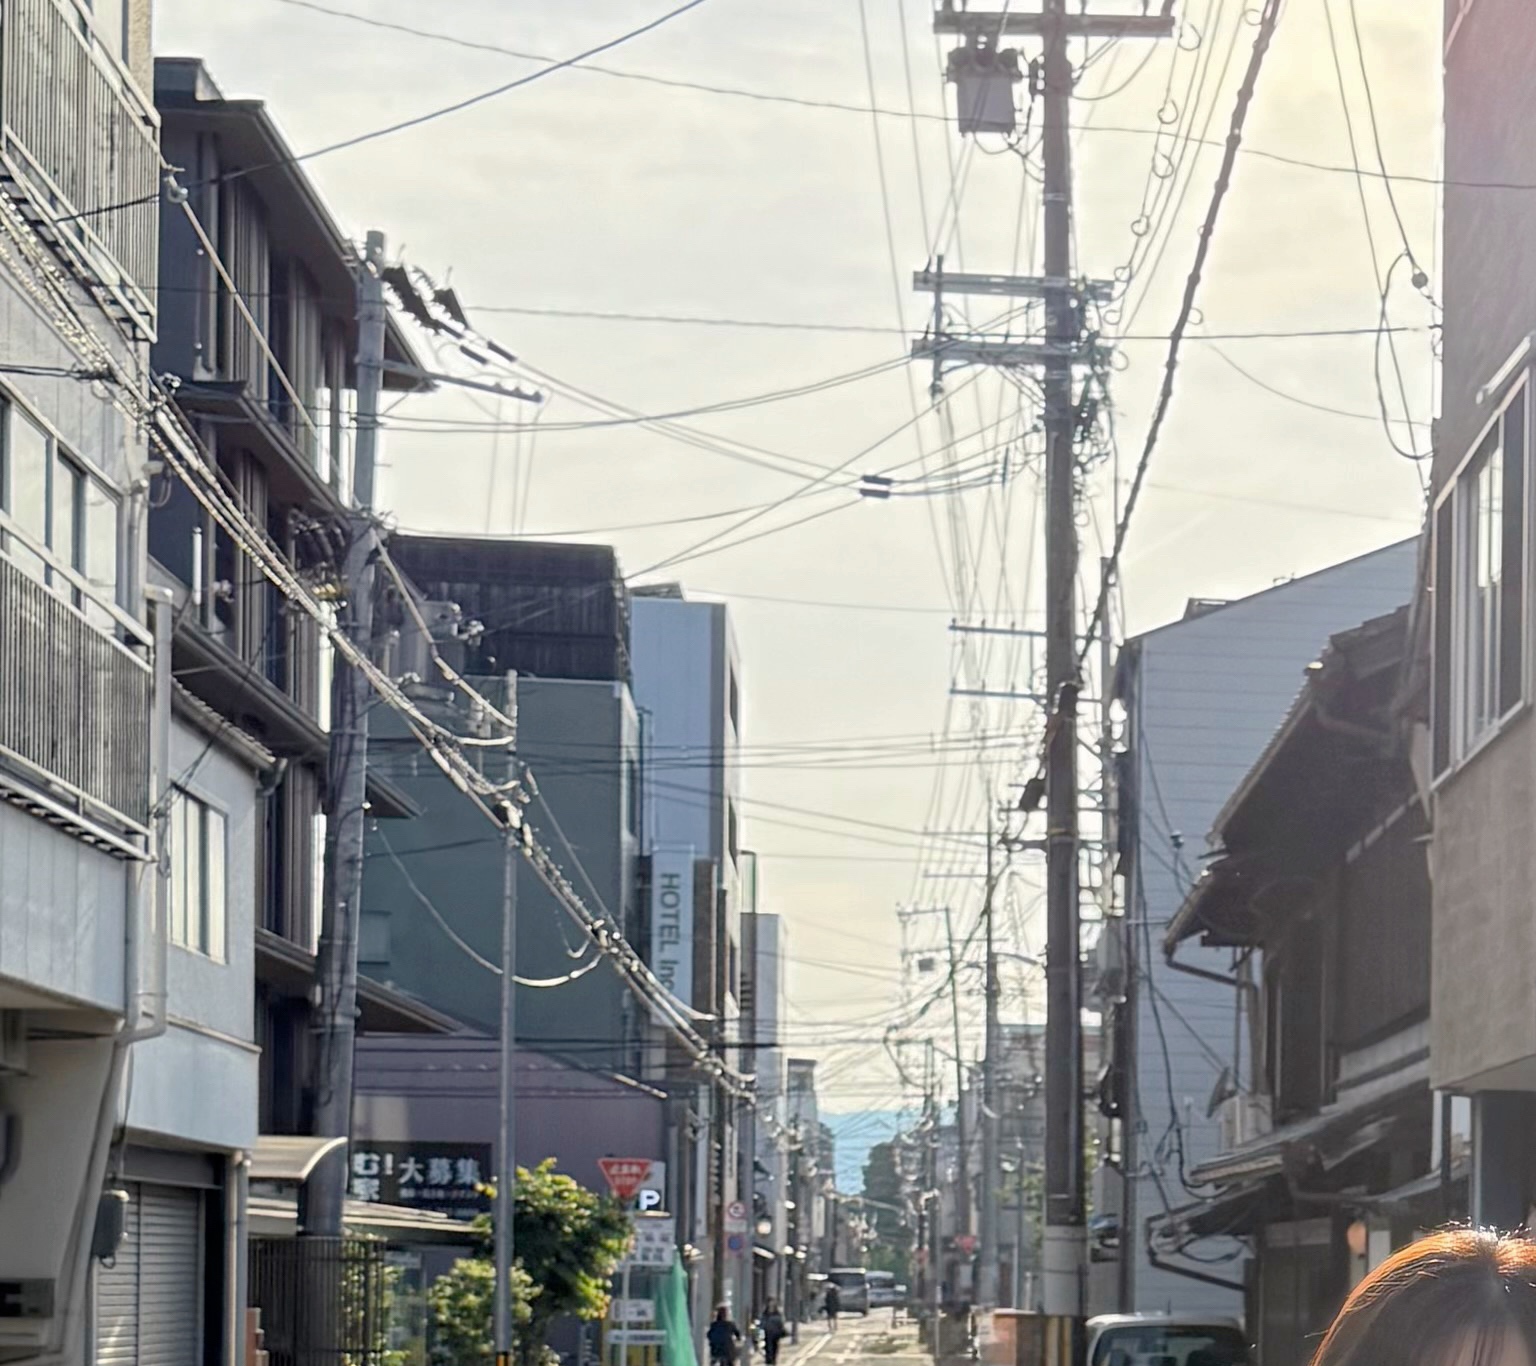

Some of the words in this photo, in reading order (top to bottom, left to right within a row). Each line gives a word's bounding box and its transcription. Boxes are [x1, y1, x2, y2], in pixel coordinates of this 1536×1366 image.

[659, 873, 680, 952] HOTEL
[398, 1157, 480, 1184] 大募集
[640, 1190, 660, 1210] P
